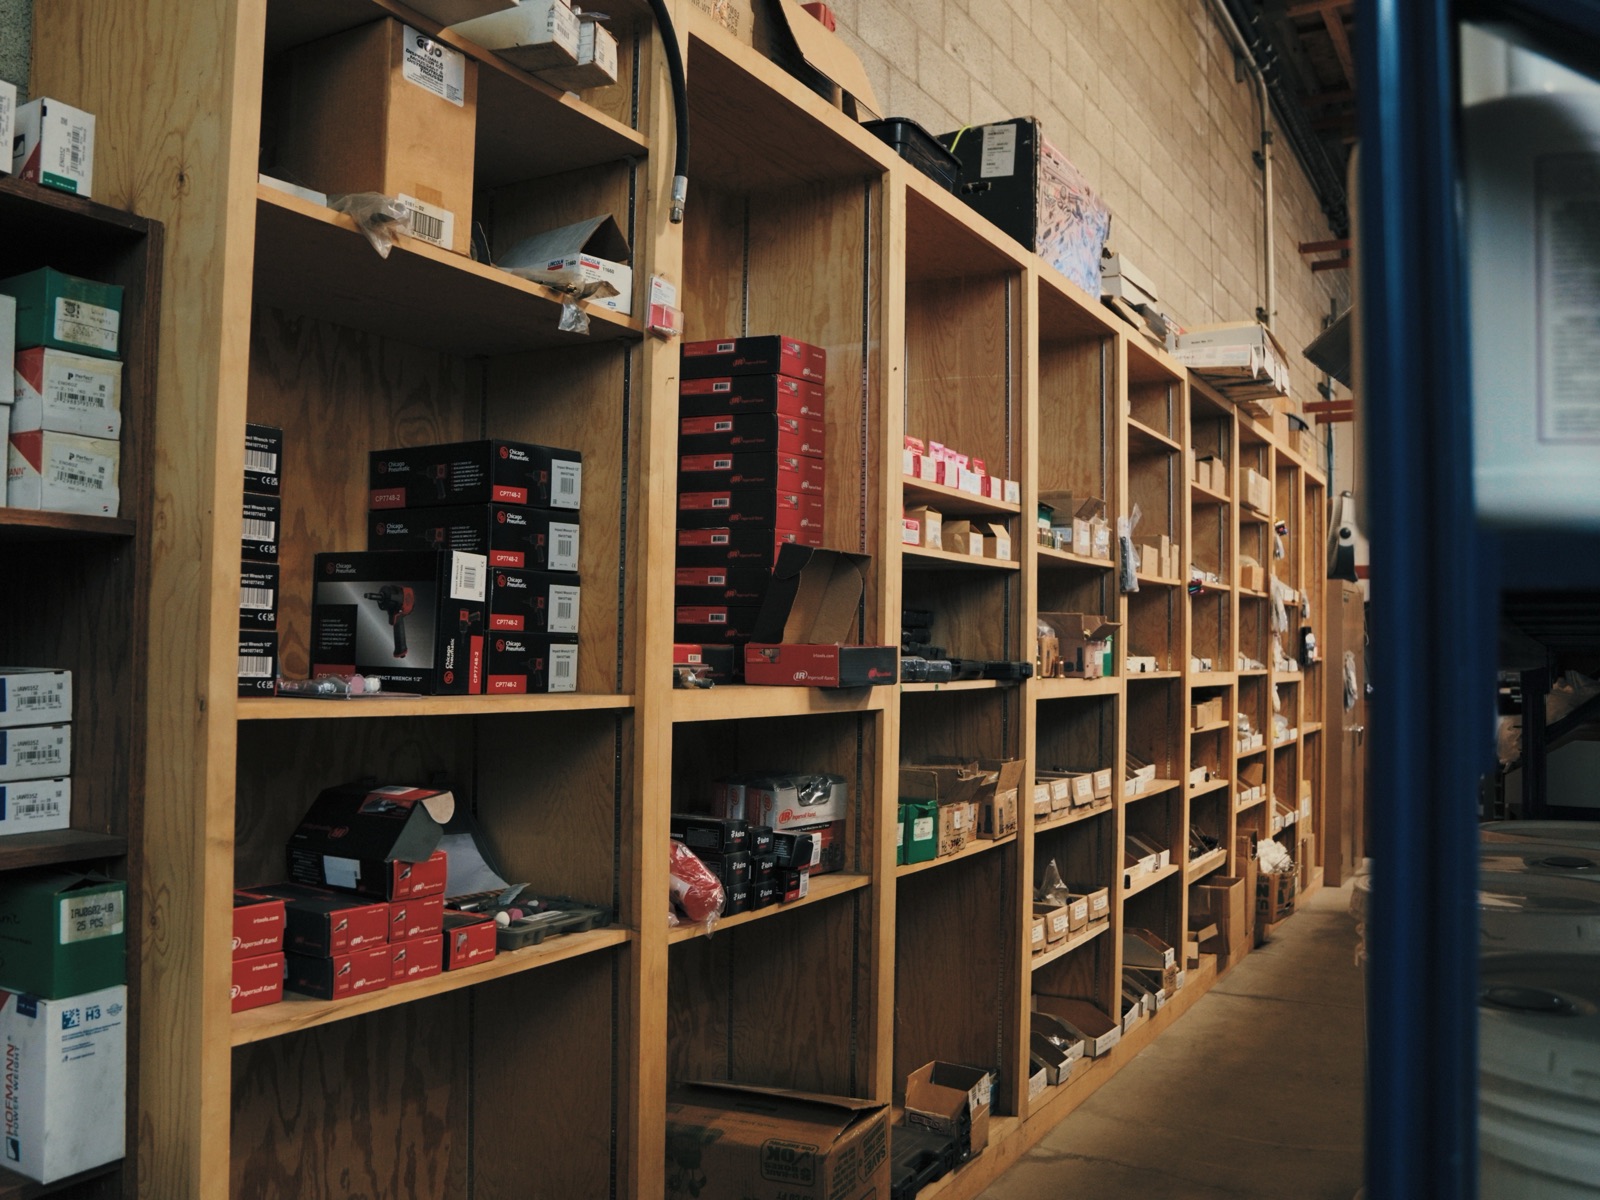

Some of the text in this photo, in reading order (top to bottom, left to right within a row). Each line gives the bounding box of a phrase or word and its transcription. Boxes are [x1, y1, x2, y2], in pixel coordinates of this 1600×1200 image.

[547, 258, 564, 267] LINCOLN
[580, 256, 600, 265] LINCOLN
[76, 918, 103, 931] 25 PCS
[253, 915, 279, 924] irtools.com
[240, 936, 278, 949] Ingersoll Rand
[252, 962, 278, 971] irtools.com
[240, 983, 277, 997] Ingersoll Rand
[86, 1009, 101, 1022] H3
[6, 1044, 15, 1135] HOFMANN
[766, 1146, 795, 1162] OK
